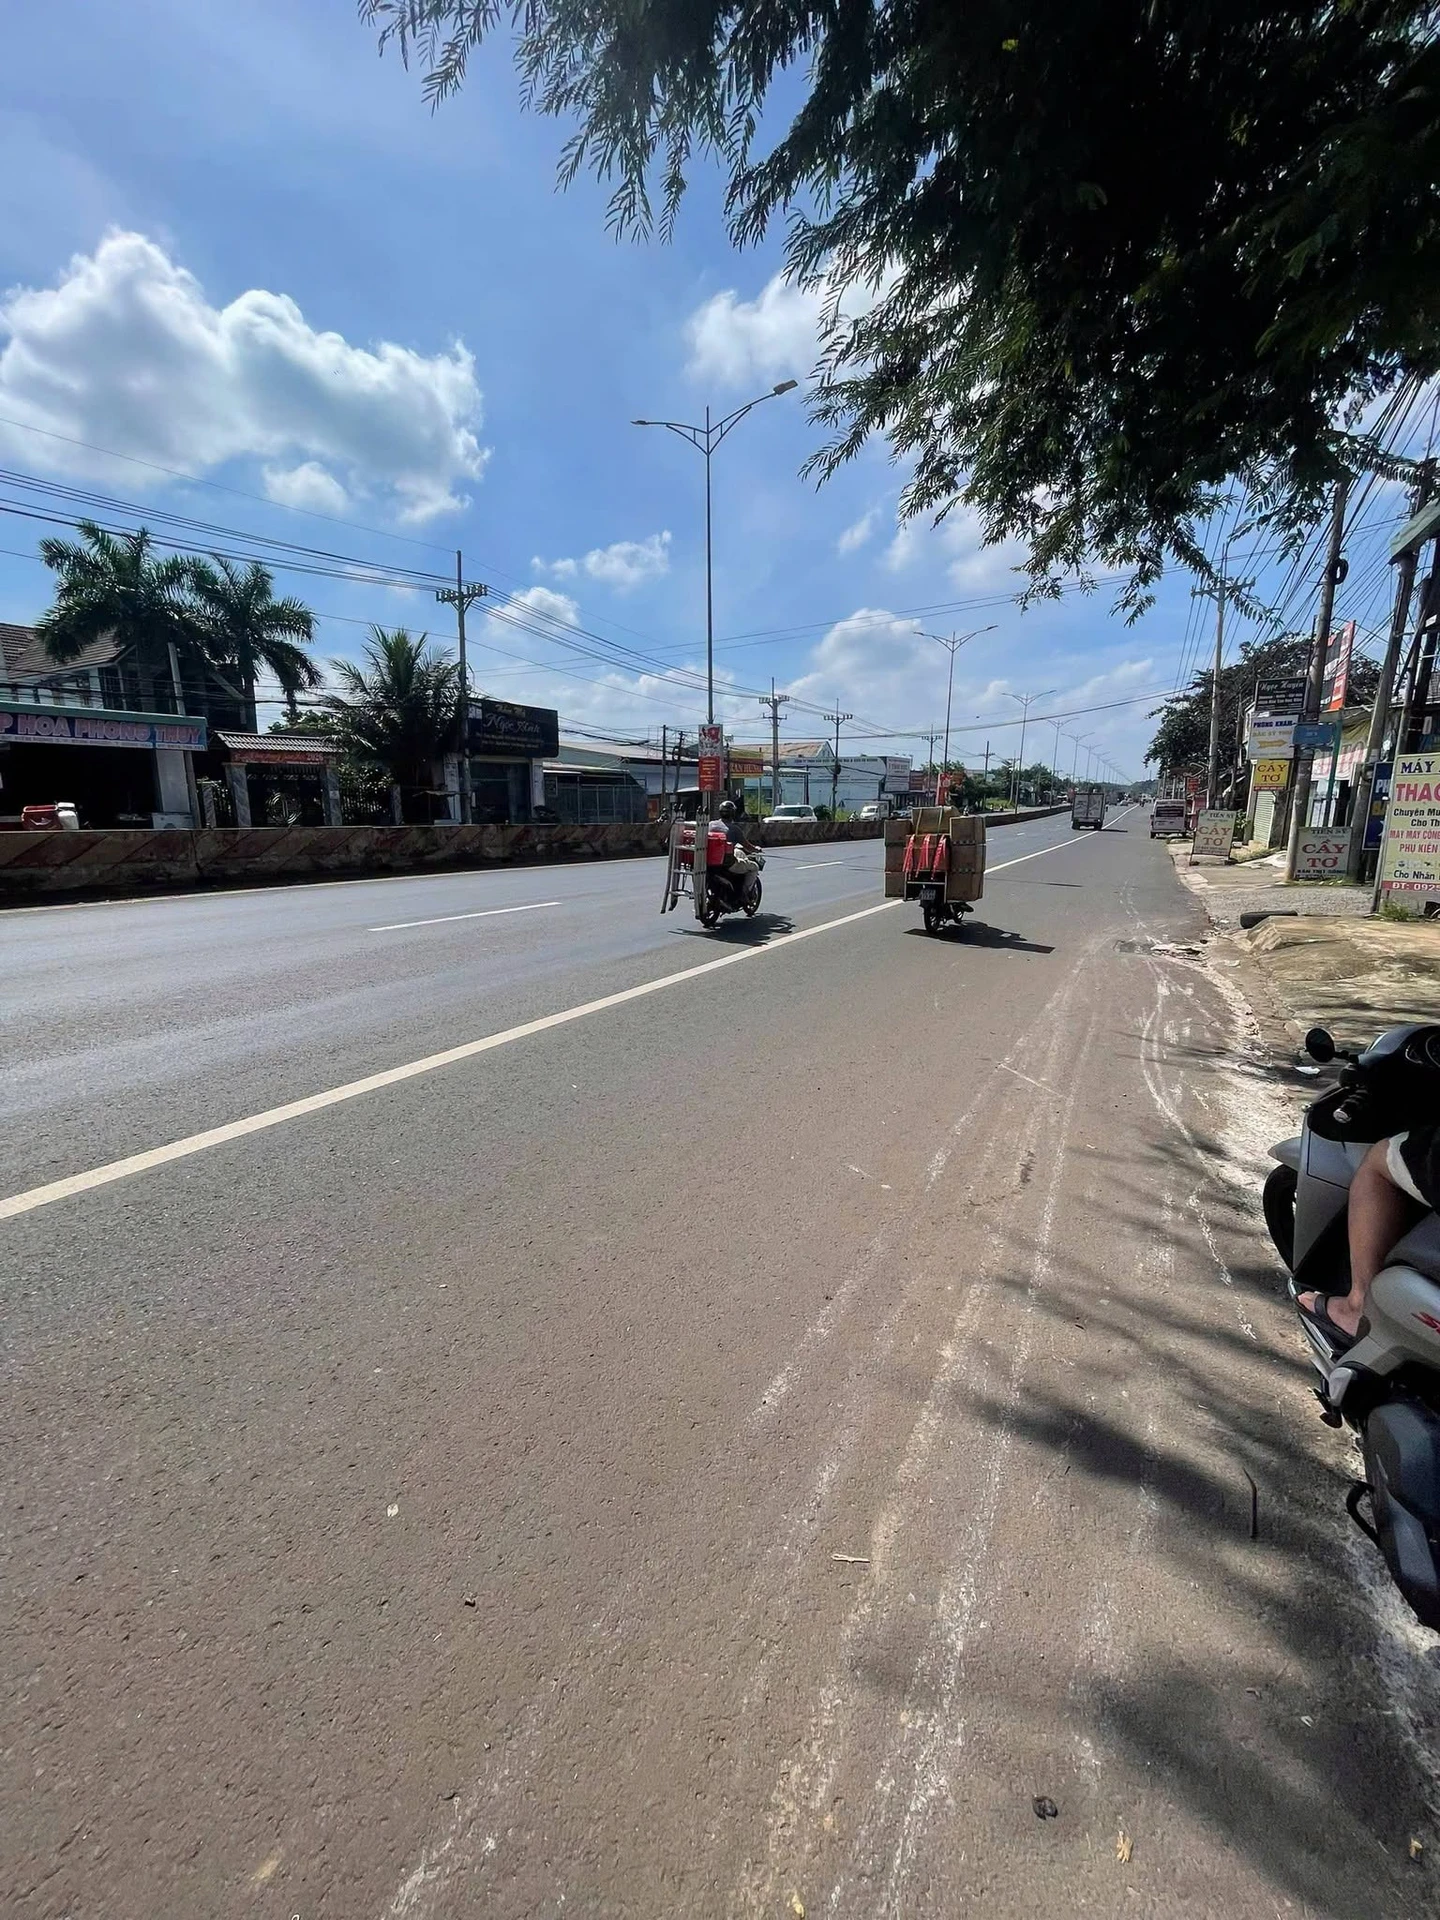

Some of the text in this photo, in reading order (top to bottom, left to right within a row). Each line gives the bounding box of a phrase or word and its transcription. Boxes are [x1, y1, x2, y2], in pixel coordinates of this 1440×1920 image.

[1401, 758, 1435, 773] MÁY
[1411, 819, 1427, 827] Cho
[1394, 870, 1409, 879] Cho
